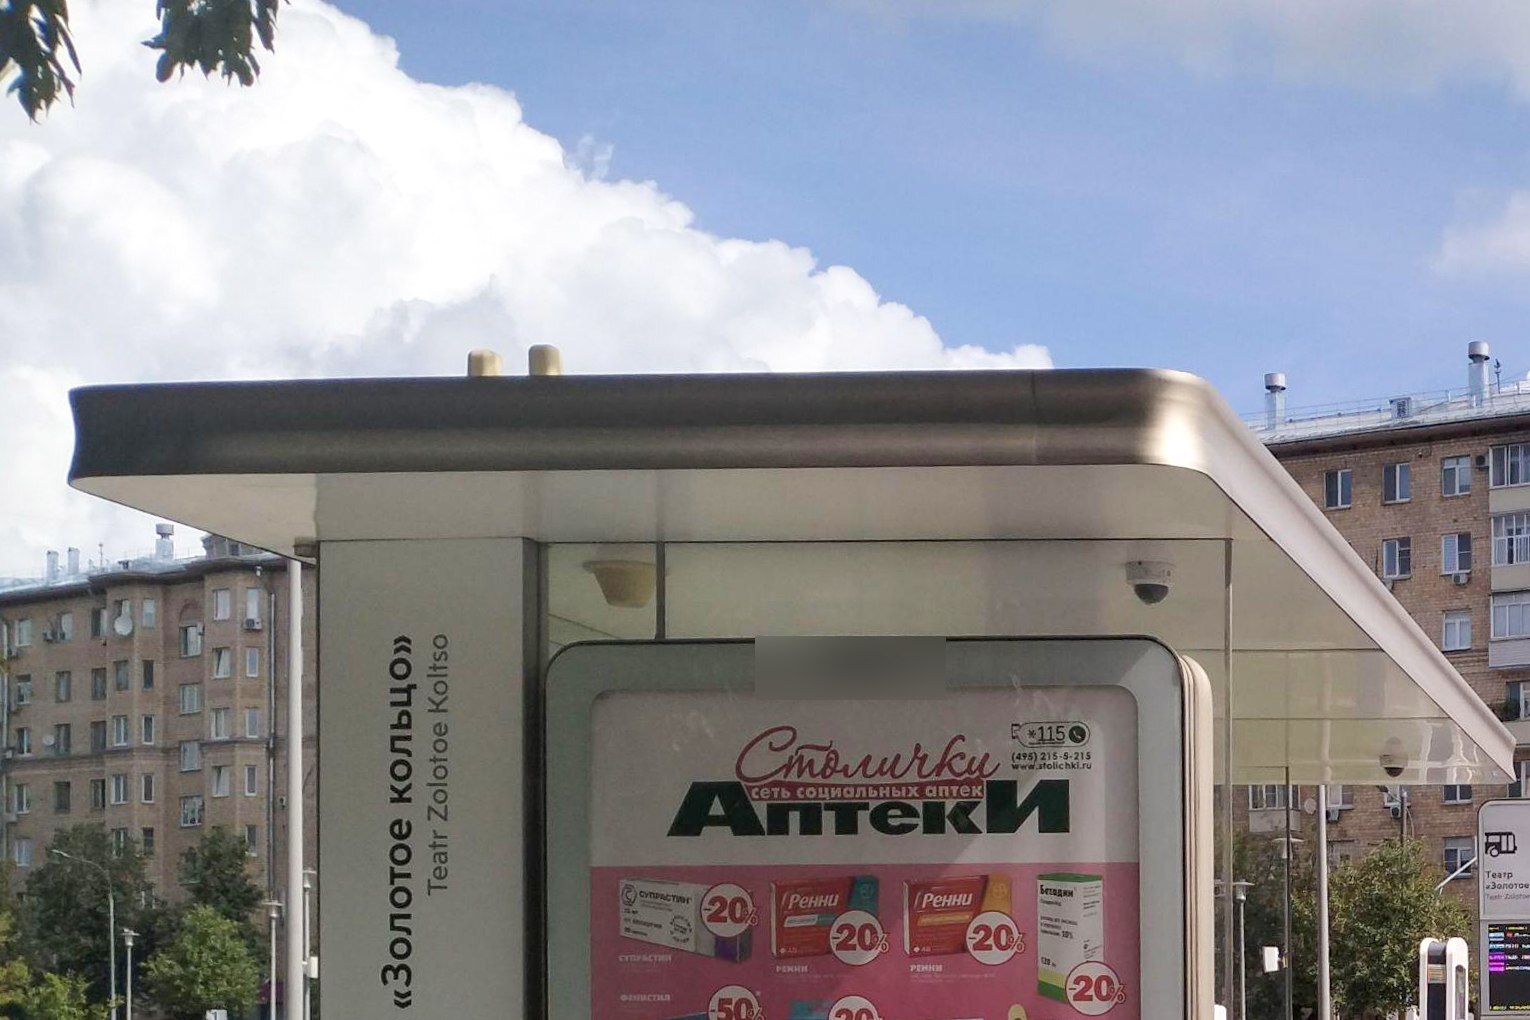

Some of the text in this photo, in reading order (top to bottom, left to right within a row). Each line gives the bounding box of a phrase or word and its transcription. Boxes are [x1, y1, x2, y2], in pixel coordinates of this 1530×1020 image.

[388, 635, 418, 804] кольцо»
[735, 724, 1001, 784] Столички
[1011, 751, 1092, 763] (495) 215-5-215
[426, 633, 448, 896] Teatr Zolotoe Koltso
[1011, 762, 1092, 771] www.stolichki.ru
[751, 783, 984, 801] сеть социальных аптек
[1486, 870, 1514, 881] Театр
[788, 893, 839, 909] Ренни
[922, 892, 973, 909] Ренни
[381, 818, 413, 1008] «Золотое
[910, 964, 943, 974] РЕННИ
